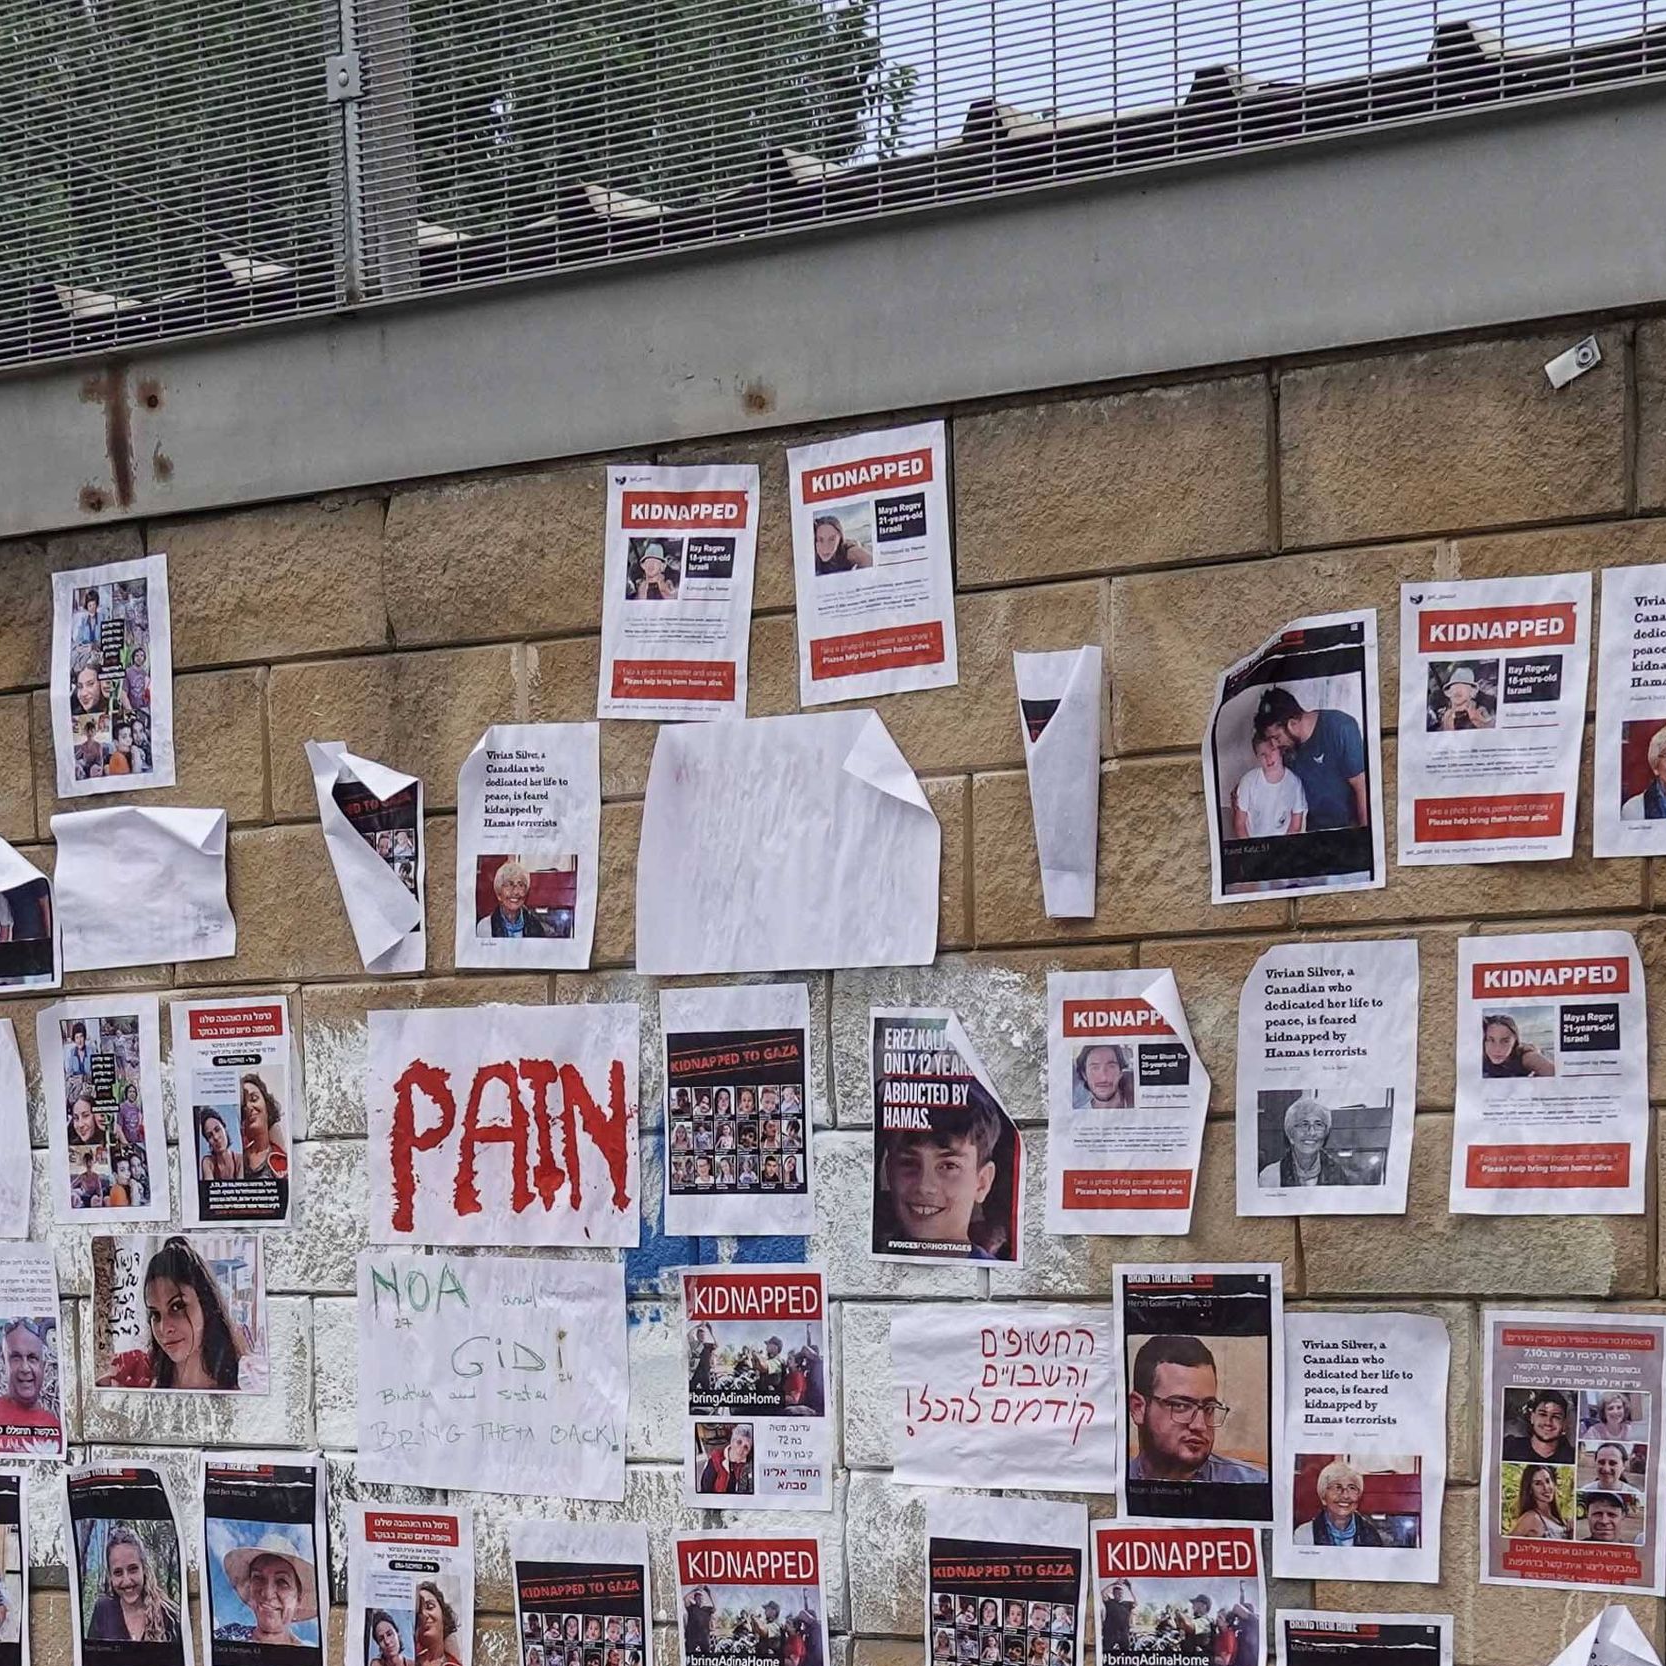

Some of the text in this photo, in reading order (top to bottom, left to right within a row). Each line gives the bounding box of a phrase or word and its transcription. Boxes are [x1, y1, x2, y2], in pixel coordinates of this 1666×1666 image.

[812, 458, 923, 492] KIDNAPPED
[631, 503, 738, 520] KIDNAPPED
[1429, 617, 1564, 641] KIDNAPPED
[1484, 966, 1617, 987] KIDNAPPED
[1073, 1008, 1162, 1027] KIDNAPP
[670, 1044, 798, 1077] KIDNAPPED TO GAZA
[883, 1082, 969, 1105] ABDUCTED BY
[883, 1107, 931, 1128] HAMAS.
[388, 1054, 635, 1235] PAIN
[370, 1261, 470, 1321] NOA
[691, 1286, 818, 1321] KIDNAPPED
[1301, 1339, 1339, 1349] Vivian
[1303, 1354, 1385, 1364] Canadian who
[1303, 1369, 1413, 1379] dedicated her life to
[1341, 1384, 1350, 1394] is
[1353, 1384, 1388, 1394] feared
[1304, 1399, 1378, 1412] kidnapped by
[1304, 1413, 1397, 1424] Hamas terrorists
[687, 1551, 813, 1578] KIDNAPPED
[1107, 1541, 1251, 1570] KIDNAPPED
[932, 1564, 1074, 1577] KIDNAPPED TO GAZA
[521, 1580, 640, 1603] KIDNAPPED TO GAZA
